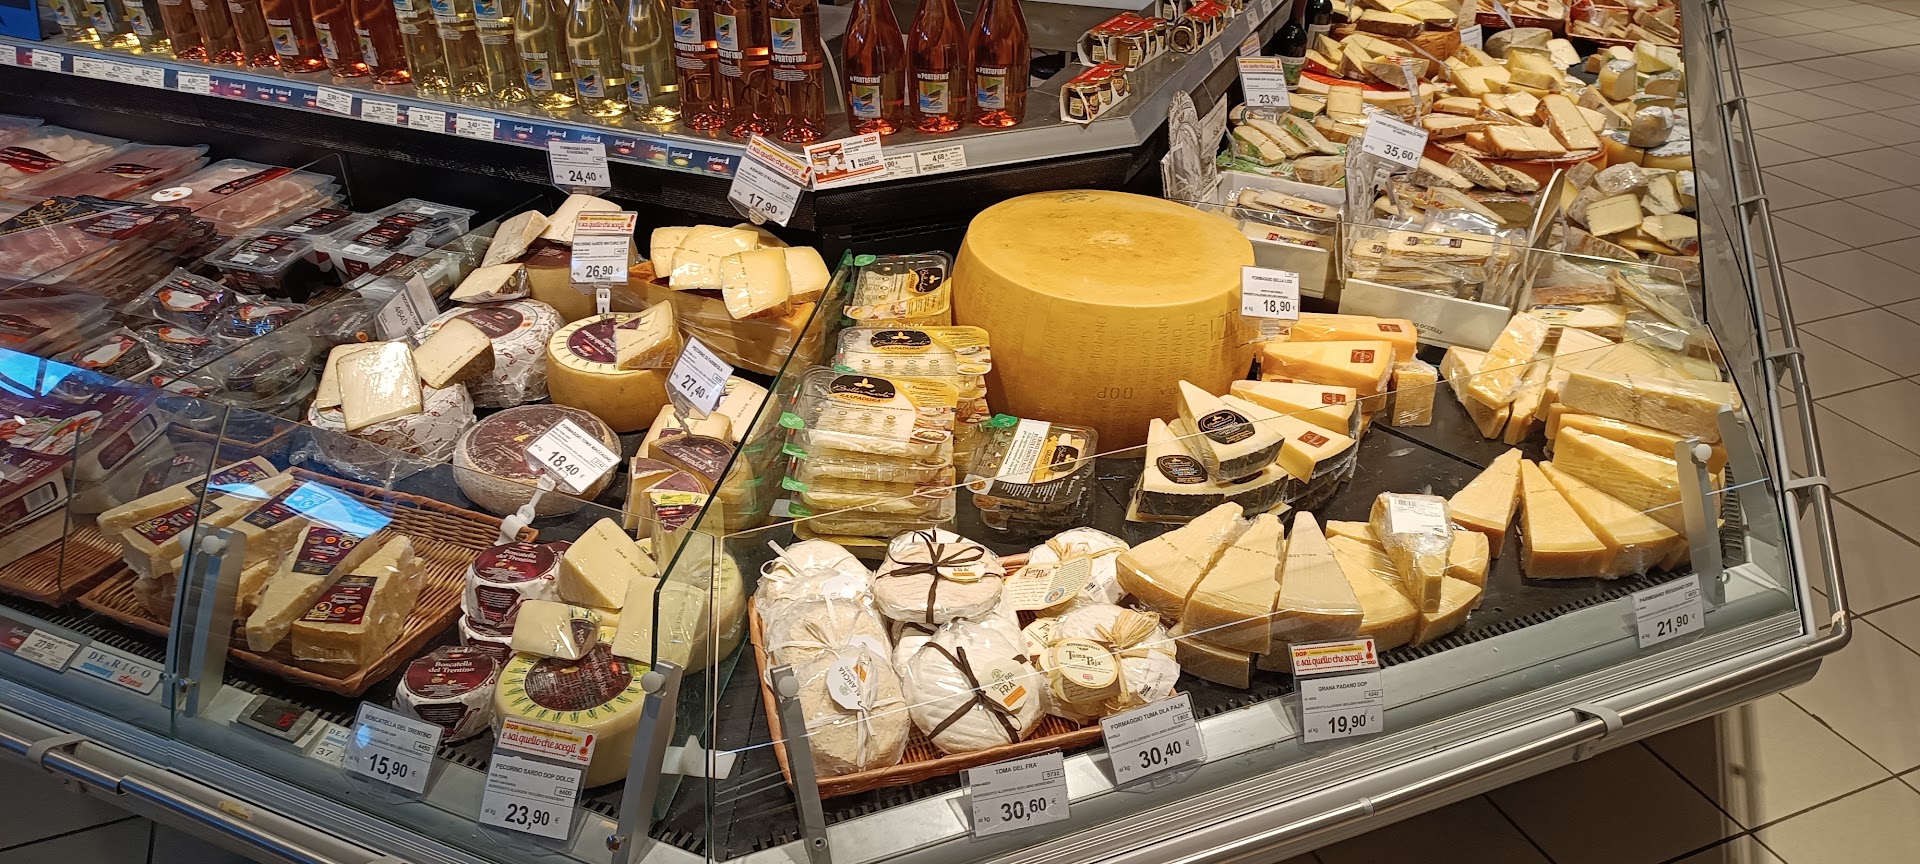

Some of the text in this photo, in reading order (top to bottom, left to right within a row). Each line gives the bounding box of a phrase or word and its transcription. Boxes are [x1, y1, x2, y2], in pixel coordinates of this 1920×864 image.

[677, 42, 706, 52] PORTOFINO
[774, 54, 807, 63] PORTOFINO
[921, 72, 950, 80] PORTOFINO
[979, 66, 1008, 74] PORTOFINO
[853, 76, 881, 84] PORTOFINO
[1259, 94, 1280, 105] 23,90
[932, 153, 945, 163] 4,68
[1384, 145, 1414, 160] 35,60
[850, 160, 857, 169] 1
[569, 170, 597, 184] 24,40
[749, 193, 777, 214] 17,90
[586, 265, 613, 278] 26,90
[1264, 299, 1290, 315] 18,90
[681, 374, 706, 398] 27,40
[840, 393, 881, 403] RASPADURA
[1097, 387, 1133, 400] DOP
[561, 423, 582, 439] FORMAGGIO
[581, 438, 592, 448] TOMA
[548, 451, 580, 475] 18,40
[503, 549, 537, 559] Boscatella
[508, 554, 537, 564] Trentino
[1023, 568, 1039, 577] Tuma
[1639, 591, 1664, 603] PARMIGIANO
[1657, 614, 1689, 637] 21,90
[1066, 650, 1086, 661] Tuma
[1301, 657, 1312, 666] sai
[1312, 656, 1332, 667] quello
[1332, 654, 1344, 663] che
[1344, 652, 1364, 665] scegli
[88, 651, 104, 664] DE
[112, 660, 152, 679] RIGO
[435, 660, 472, 669] Boscatella
[442, 666, 475, 674] Trentino
[838, 666, 861, 697] BLANCHA
[1110, 715, 1144, 730] FORMAGGIO
[1143, 711, 1159, 720] TUMA
[1159, 707, 1170, 715] DLA
[1328, 714, 1366, 735] 19,90
[365, 714, 397, 729] BOSCATELLA
[408, 727, 432, 739] TRENTINO
[506, 723, 519, 731] DOP
[507, 732, 519, 741] sai
[520, 735, 540, 746] quello
[541, 738, 554, 749] che
[554, 741, 576, 755] scegli
[316, 748, 334, 757] 37
[1139, 741, 1181, 768] 30,40
[370, 753, 408, 780] 15,90
[496, 763, 575, 783] PECORINO SARDO DOP DOLCE
[1001, 797, 1047, 821] 30,60
[505, 803, 550, 830] 23,90
